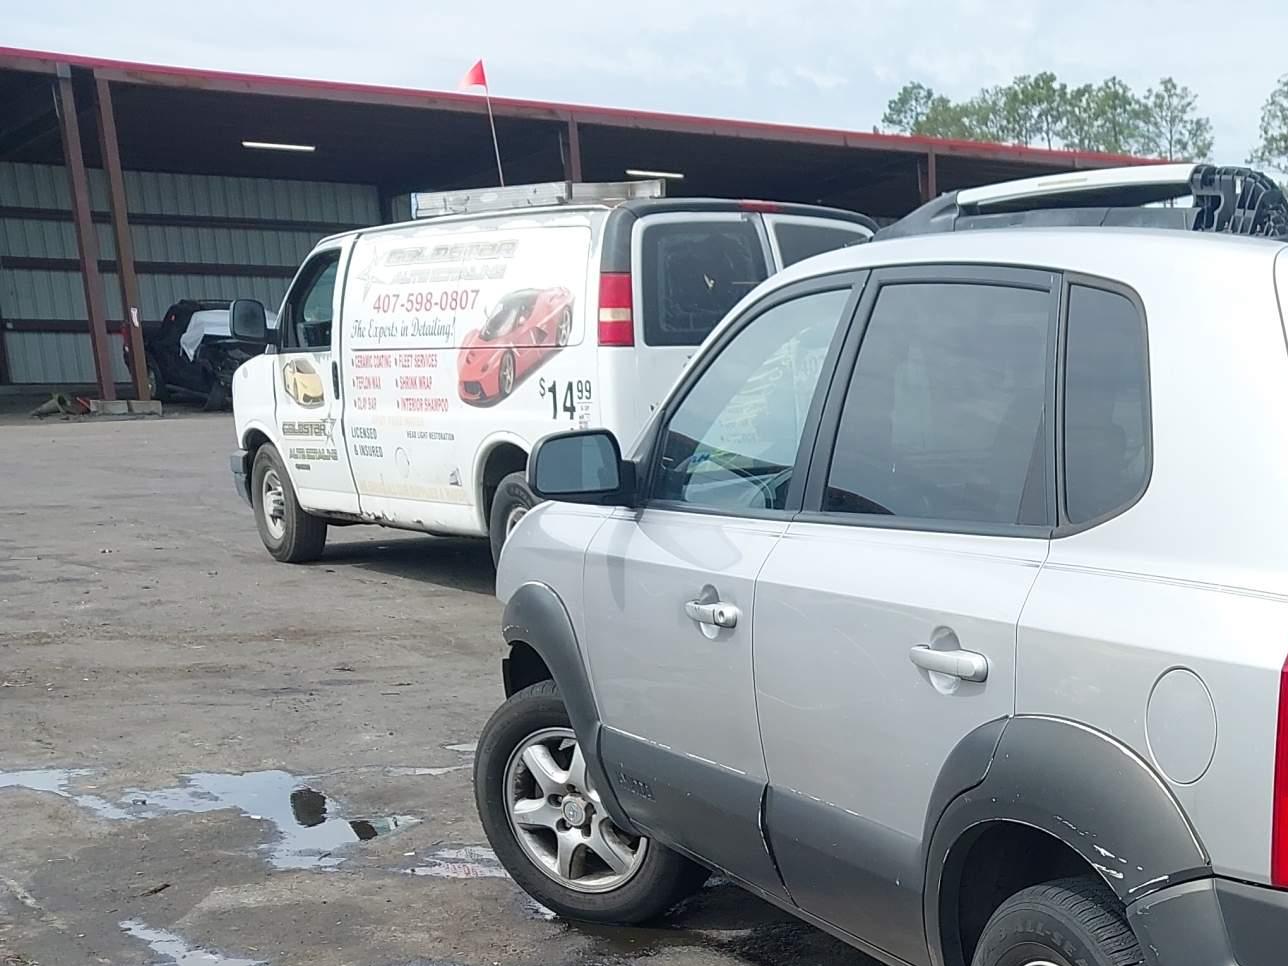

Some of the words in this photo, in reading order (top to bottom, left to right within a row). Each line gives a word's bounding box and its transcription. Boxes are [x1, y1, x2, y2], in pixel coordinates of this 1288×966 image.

[372, 290, 480, 314] 407-598-0807
[351, 319, 366, 339] The
[367, 320, 398, 340] Experts
[401, 320, 409, 336] in
[410, 316, 455, 340] Detailing!
[398, 353, 413, 368] FLEET
[414, 353, 438, 368] SERVICES
[400, 398, 423, 412] INTERIOR
[423, 398, 449, 412] SHAMPOO
[351, 425, 378, 440] LICENSED
[429, 431, 455, 441] RESTORATION
[359, 443, 384, 458] INSURED
